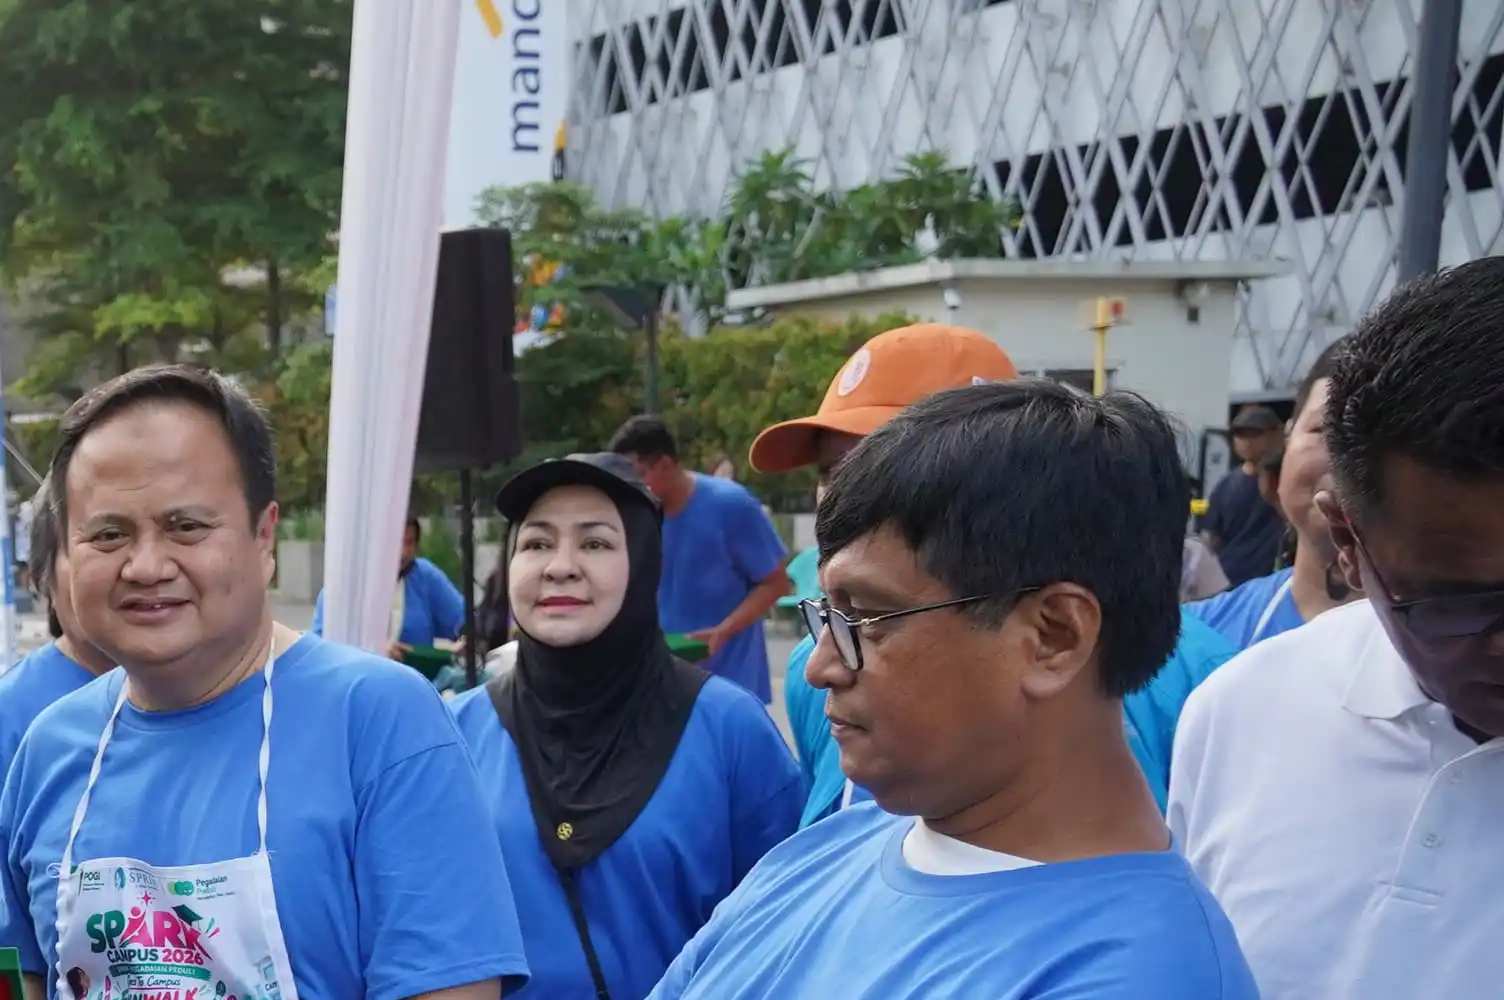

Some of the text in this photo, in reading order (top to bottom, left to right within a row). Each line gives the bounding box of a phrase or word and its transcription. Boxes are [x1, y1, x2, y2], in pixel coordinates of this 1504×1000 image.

[86, 907, 213, 961] SPARK
[162, 949, 204, 965] 2026
[147, 976, 181, 986] Campus
